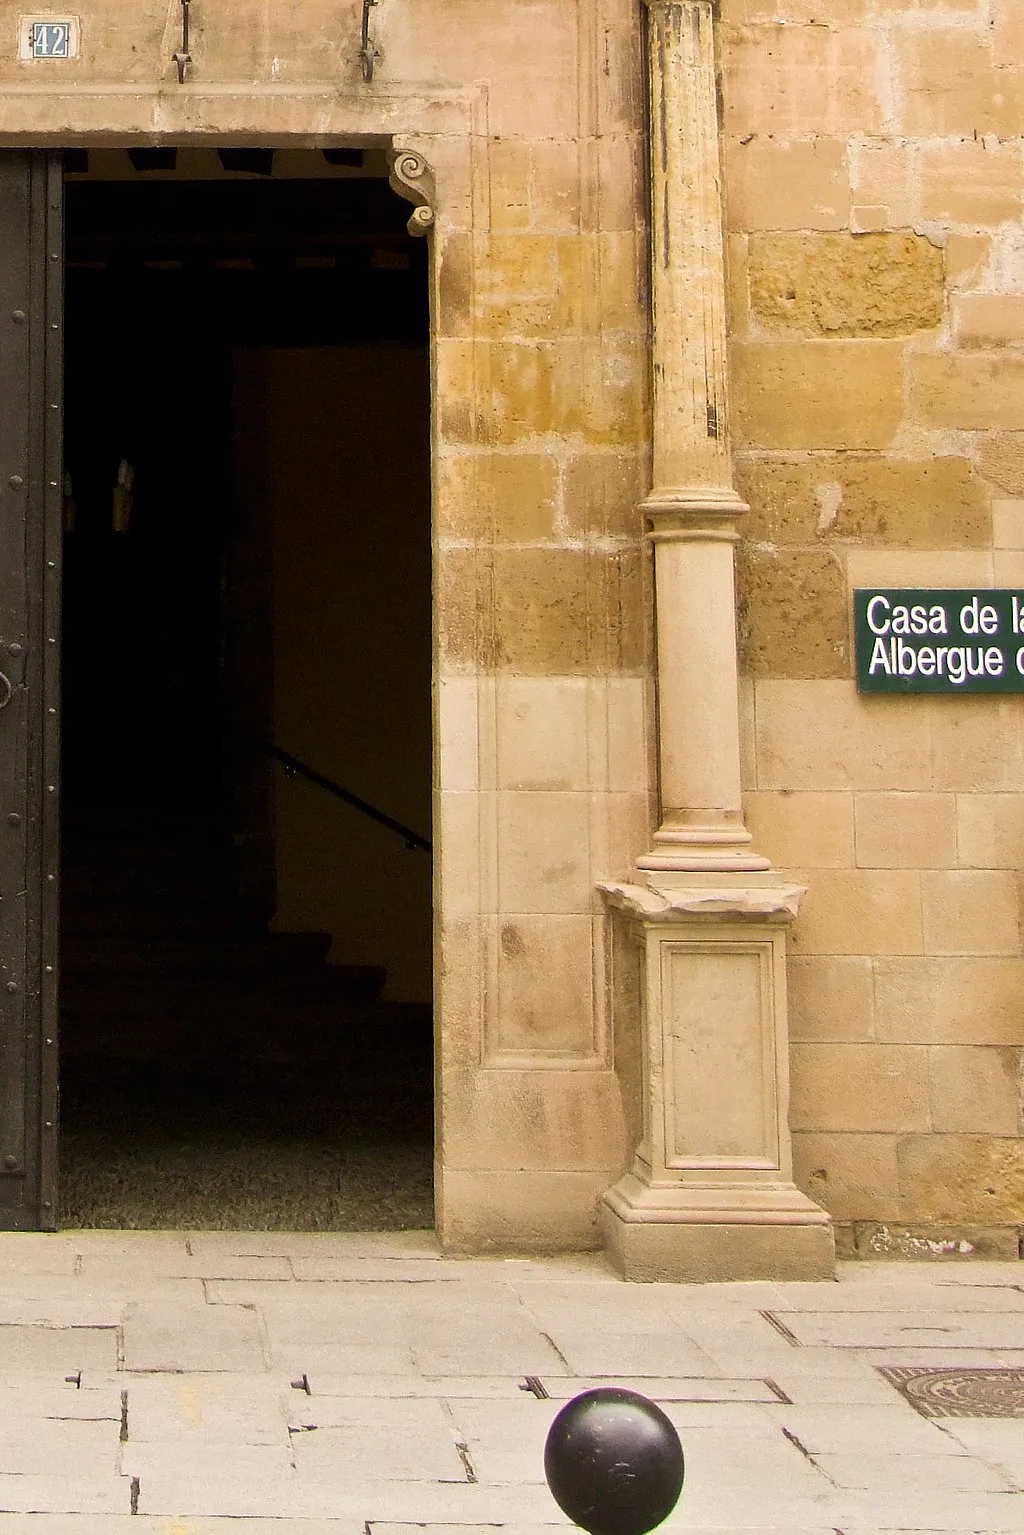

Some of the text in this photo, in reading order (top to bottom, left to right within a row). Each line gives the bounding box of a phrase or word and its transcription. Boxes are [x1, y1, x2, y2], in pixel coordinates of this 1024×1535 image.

[36, 26, 64, 55] 42
[866, 595, 1024, 635] Casa de l
[868, 637, 1003, 684] Albergue
